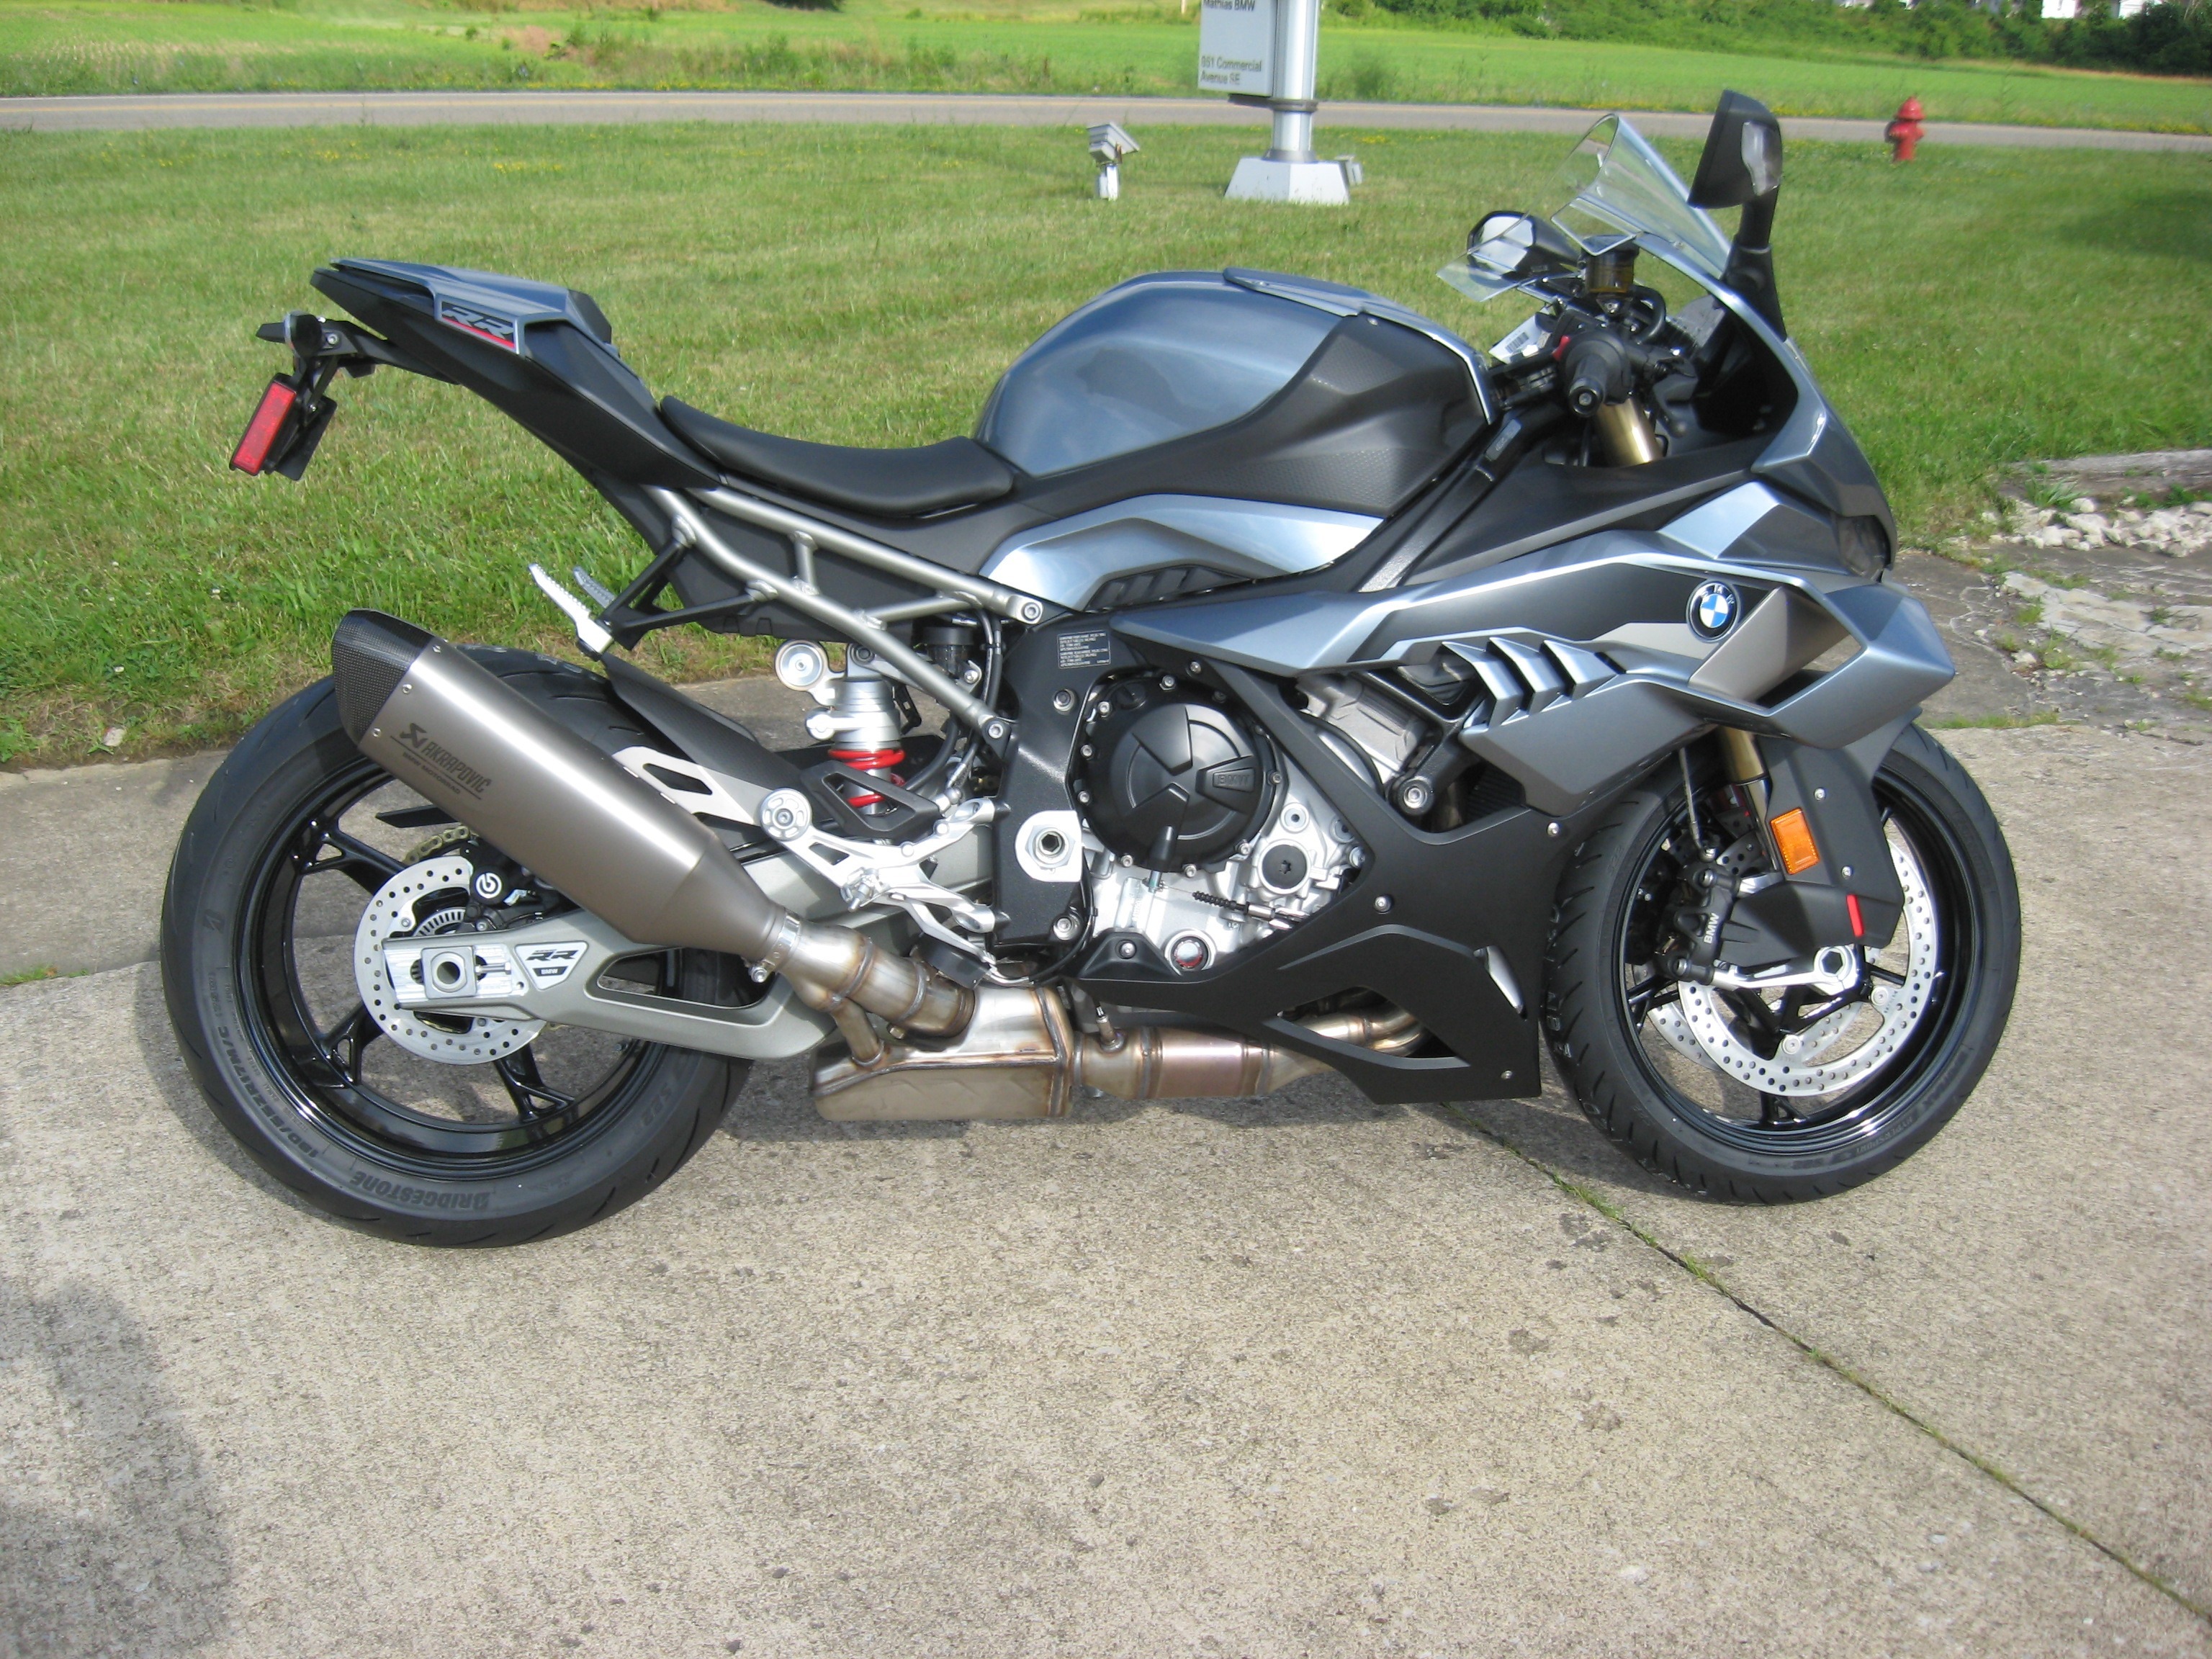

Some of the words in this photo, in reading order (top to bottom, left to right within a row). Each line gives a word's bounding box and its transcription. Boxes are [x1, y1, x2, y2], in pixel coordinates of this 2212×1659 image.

[1234, 0, 1255, 12] BMW
[1216, 57, 1262, 72] Commercial
[441, 306, 514, 340] RR
[1703, 912, 1720, 944] BMW
[525, 950, 579, 961] RR
[349, 1171, 491, 1210] BRIDGESTONE
